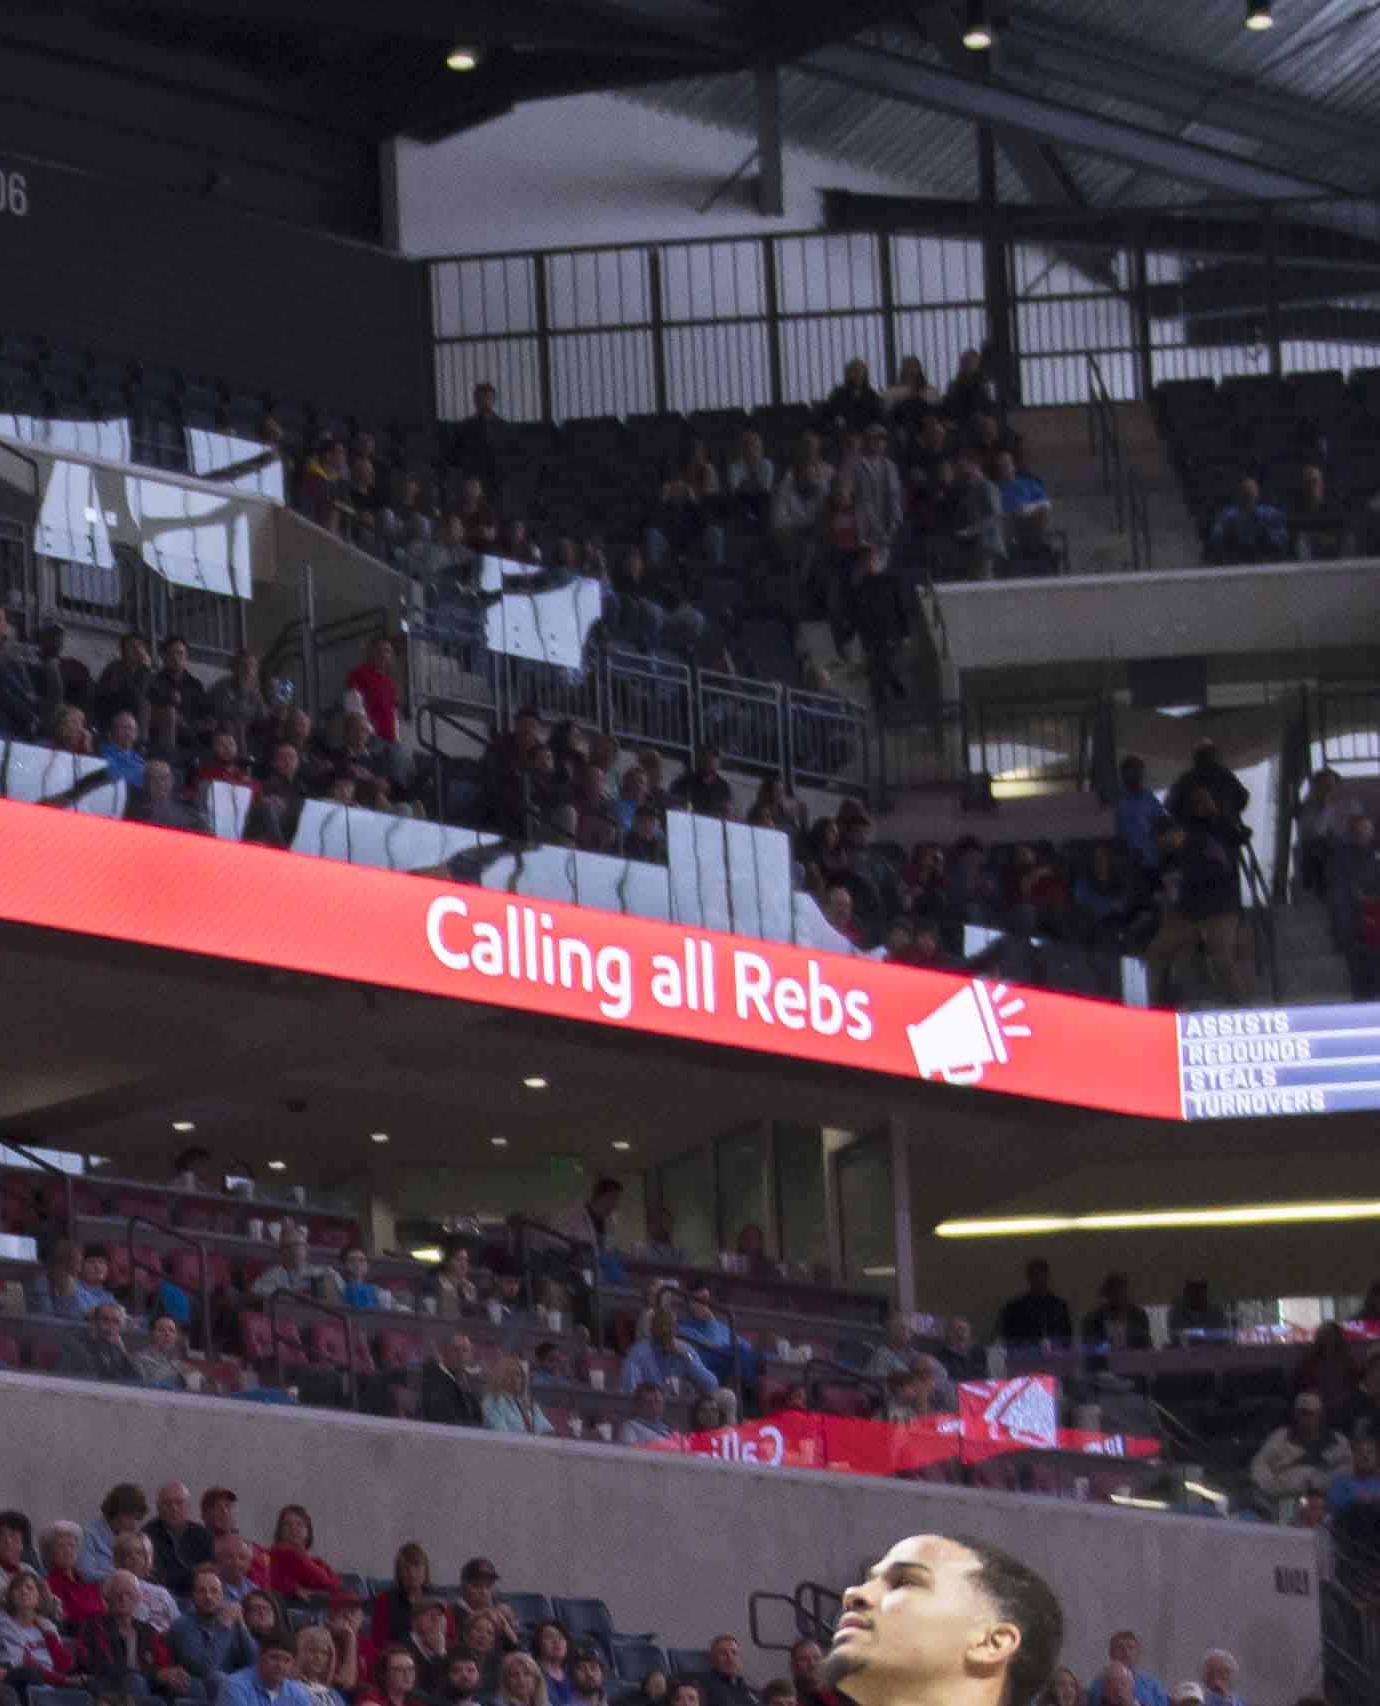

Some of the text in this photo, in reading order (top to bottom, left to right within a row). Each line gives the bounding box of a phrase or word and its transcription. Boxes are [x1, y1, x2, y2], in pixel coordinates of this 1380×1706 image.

[426, 895, 873, 1041] Calling all Rebs
[1186, 1012, 1290, 1038] ASSISTS
[1189, 1039, 1311, 1066] REBOUNDS
[1190, 1067, 1277, 1092] STEALS
[1189, 1088, 1327, 1118] TURNOVERS
